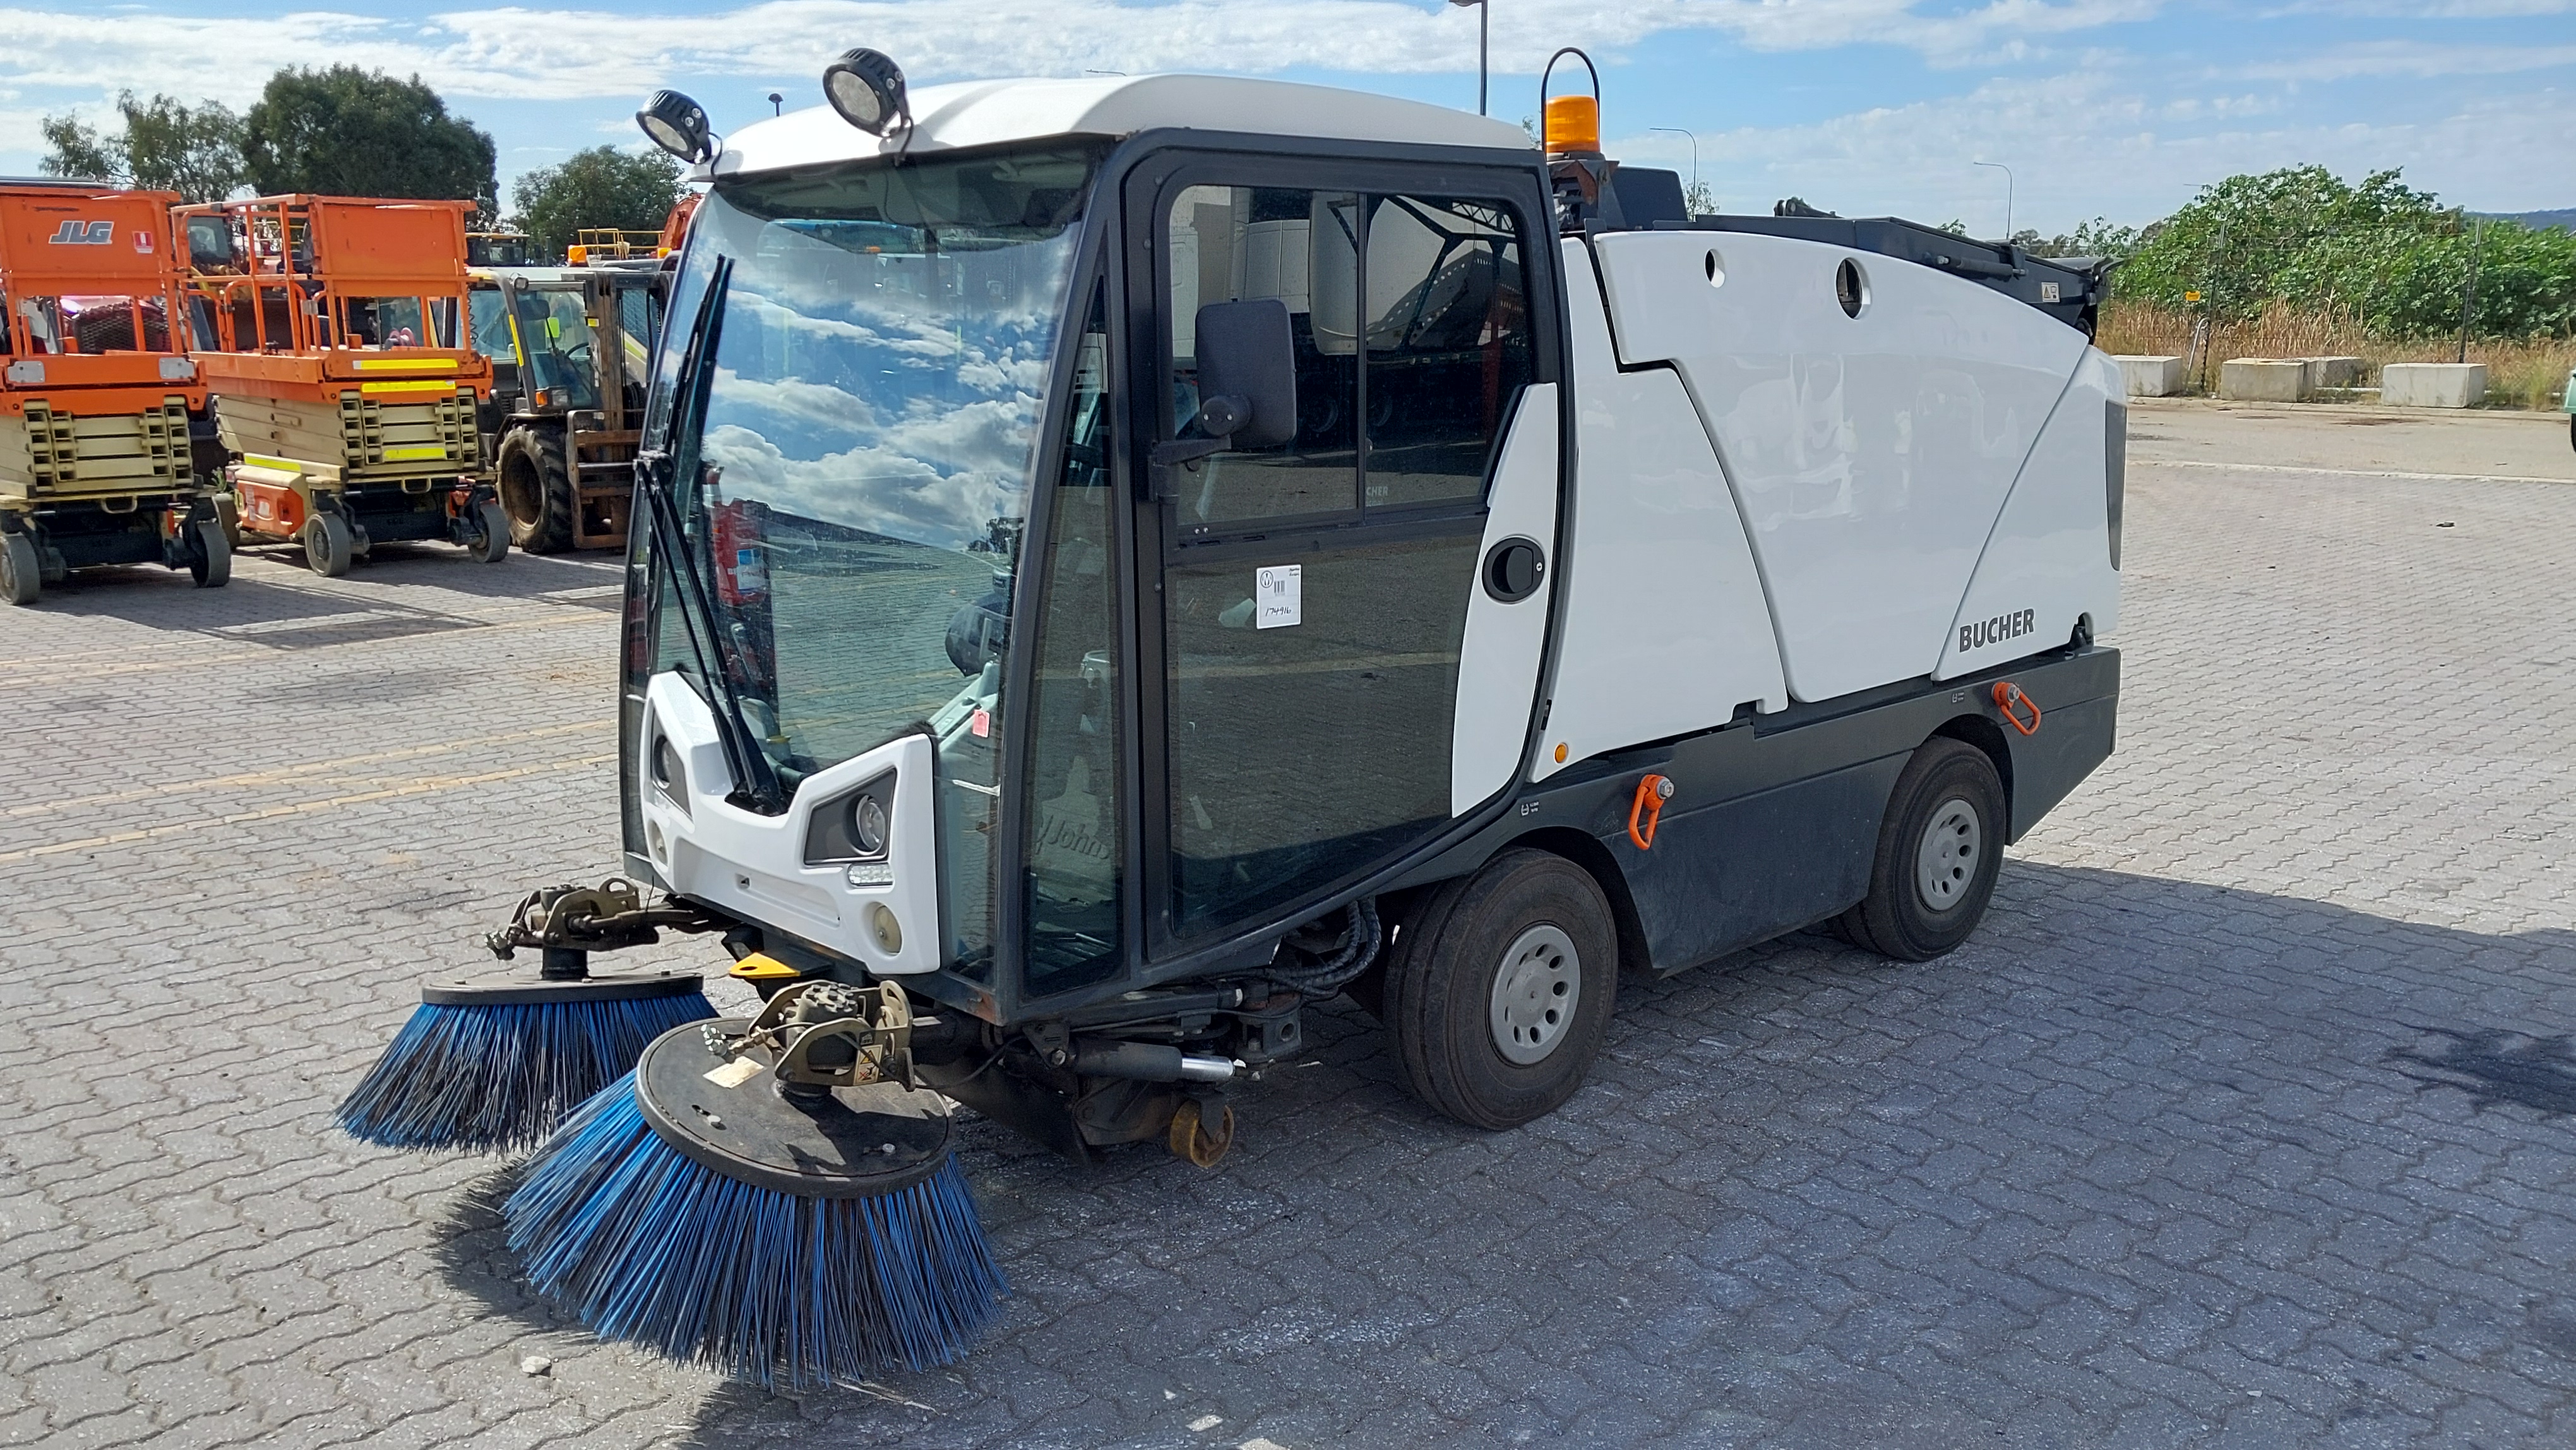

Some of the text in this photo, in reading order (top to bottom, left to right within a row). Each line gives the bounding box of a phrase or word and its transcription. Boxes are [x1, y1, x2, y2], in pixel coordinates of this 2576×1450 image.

[49, 220, 114, 244] JLG
[1366, 486, 1388, 497] CHER
[1959, 608, 2035, 653] BUCHER
